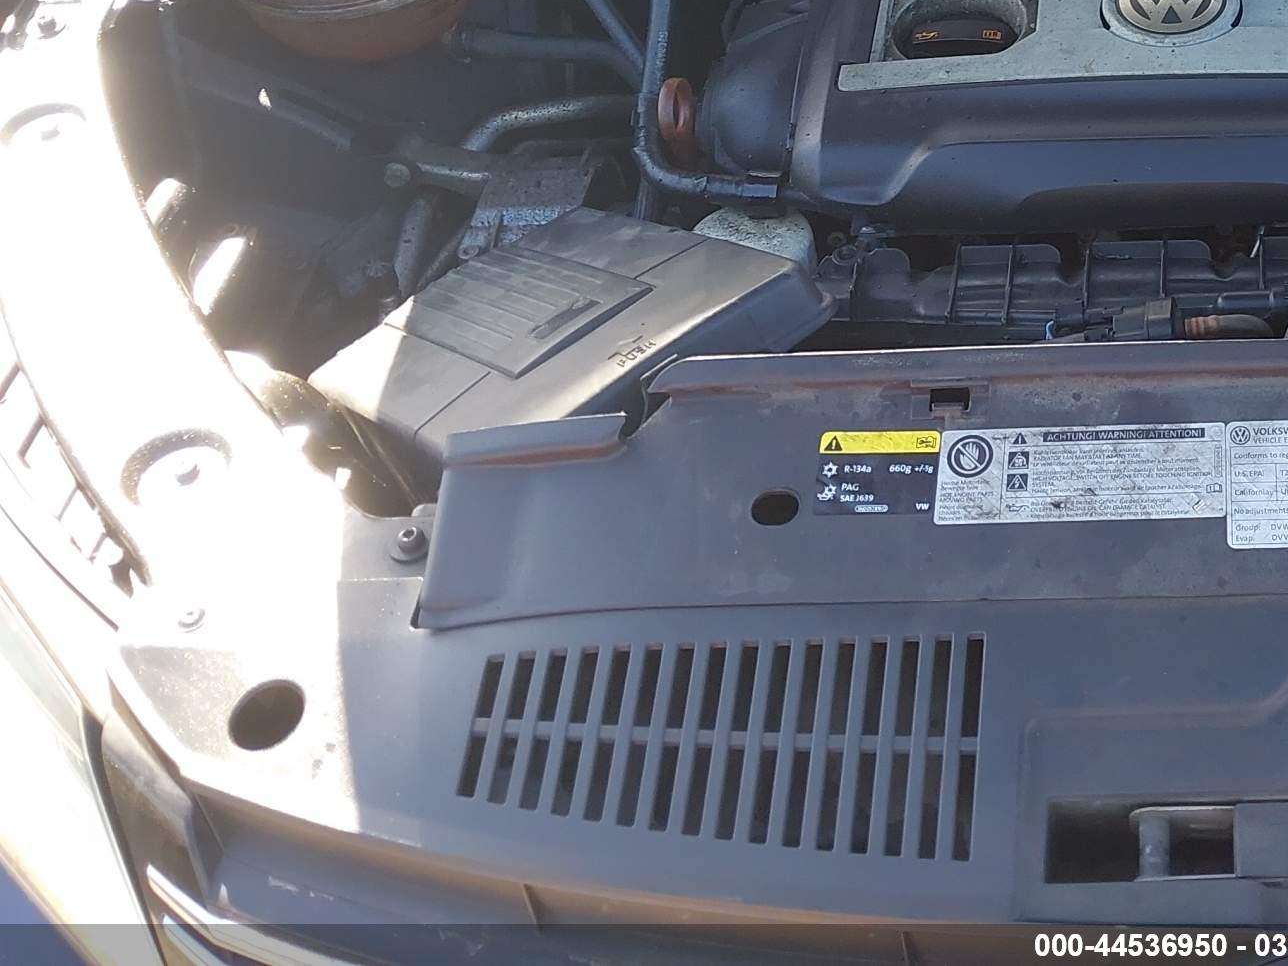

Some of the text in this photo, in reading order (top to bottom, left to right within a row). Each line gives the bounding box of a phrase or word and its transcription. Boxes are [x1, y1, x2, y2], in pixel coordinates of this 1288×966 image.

[1047, 429, 1202, 442] ACHTUNG! WARNING! ATTENTION!
[1253, 436, 1282, 444] VEHICLE
[1234, 451, 1268, 459] Conforms
[844, 464, 872, 475] R-134a
[889, 464, 912, 475] 660g
[841, 483, 859, 492] PAG
[840, 494, 855, 504] SAE
[915, 503, 930, 512] VW
